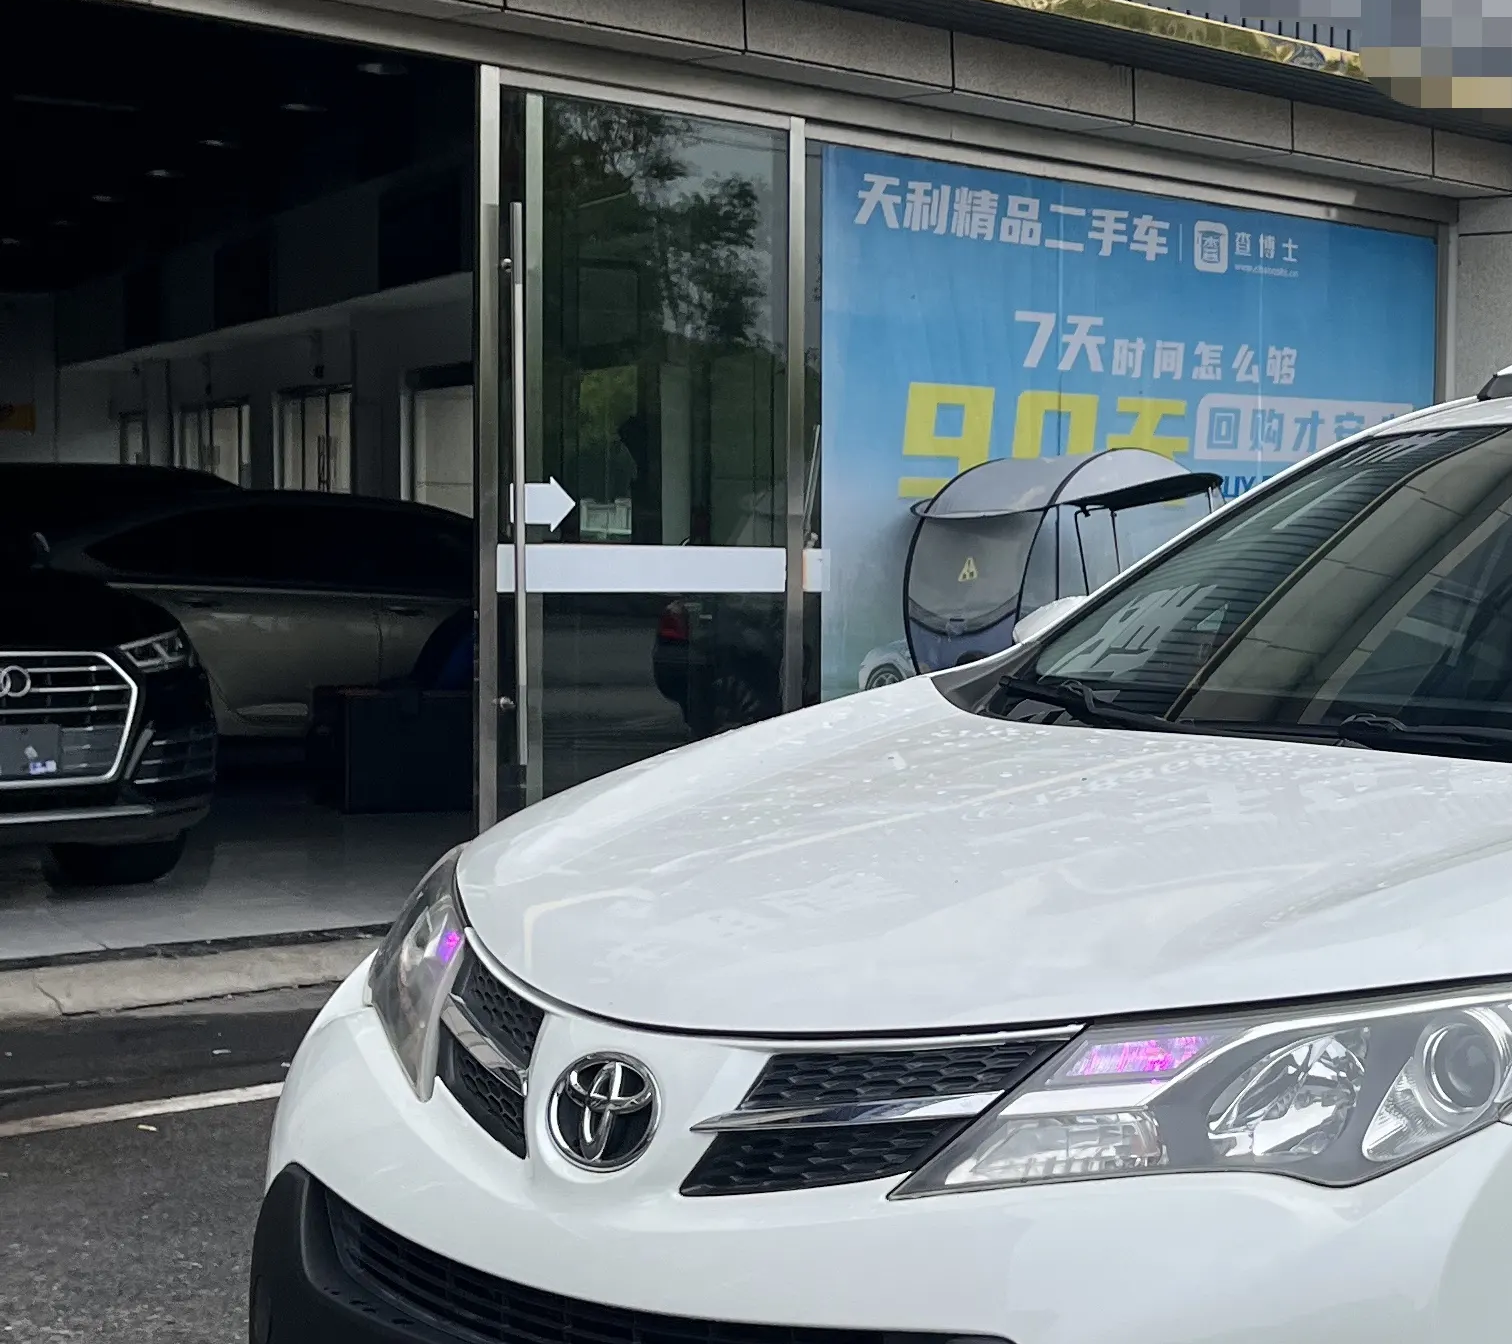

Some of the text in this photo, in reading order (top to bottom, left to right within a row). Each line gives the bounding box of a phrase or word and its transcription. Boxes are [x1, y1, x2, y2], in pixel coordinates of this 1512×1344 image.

[855, 173, 1170, 261] 天利精品二手车
[1014, 310, 1298, 385] 7天时间怎么够
[1207, 407, 1395, 452] 回购才安
